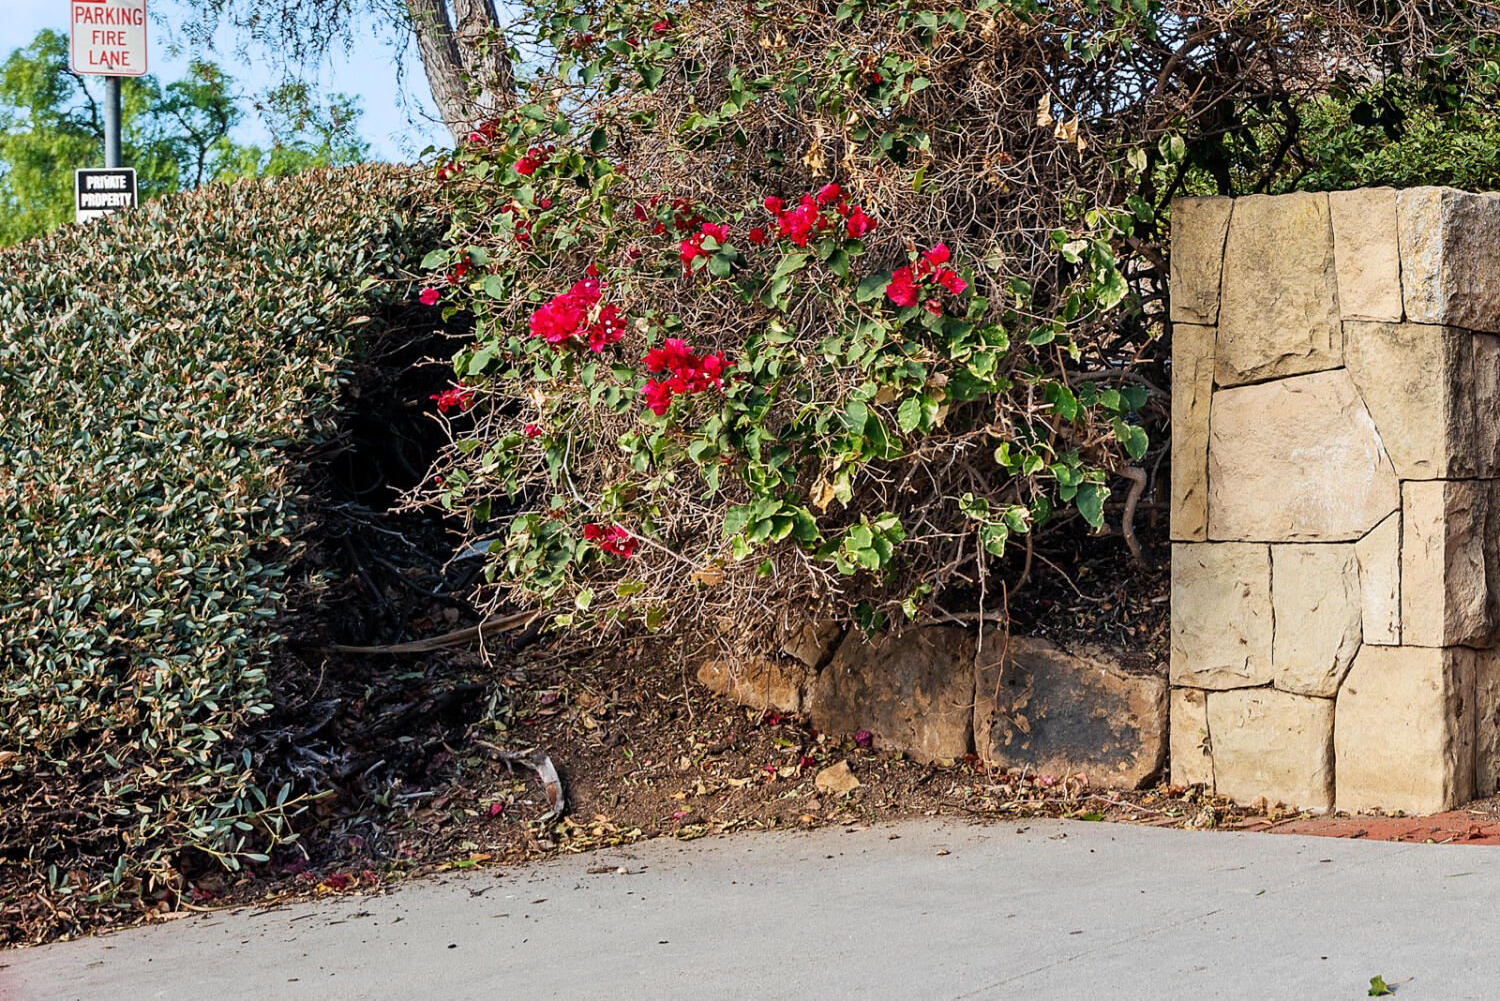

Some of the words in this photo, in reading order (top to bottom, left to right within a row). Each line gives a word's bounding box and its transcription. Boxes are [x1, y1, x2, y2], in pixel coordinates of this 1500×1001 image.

[75, 6, 143, 26] PARKING
[92, 30, 127, 46] FIRE
[89, 50, 131, 66] LANE
[86, 175, 126, 189] PRIVATE
[81, 192, 132, 207] PROPERTY
